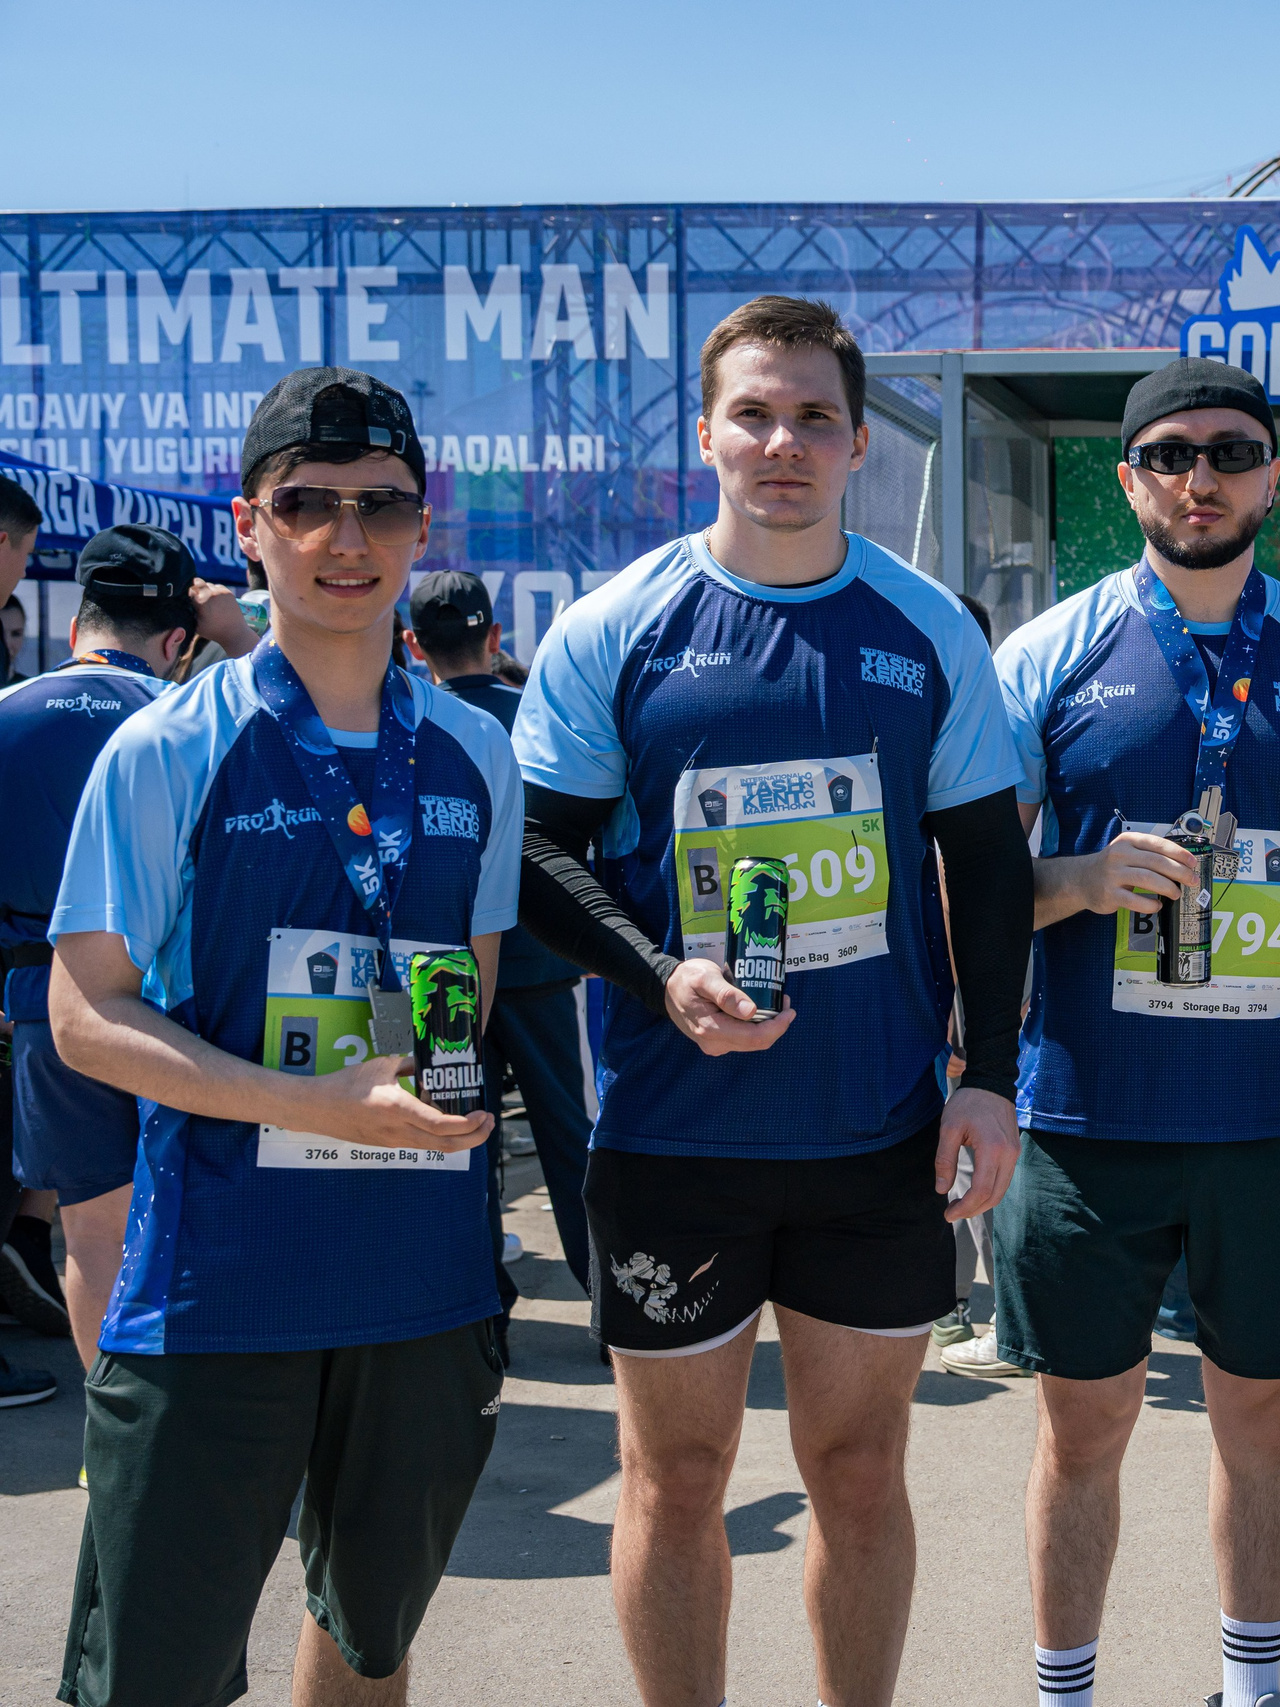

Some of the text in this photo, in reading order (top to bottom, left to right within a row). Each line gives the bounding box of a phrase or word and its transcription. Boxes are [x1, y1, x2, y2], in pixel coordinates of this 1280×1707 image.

[444, 263, 671, 361] MAN
[139, 392, 190, 430] VA
[105, 437, 245, 475] YUGURI
[695, 652, 732, 668] RUN
[860, 650, 917, 681] TASH
[861, 661, 916, 689] KENT
[46, 698, 122, 711] PRO RUN
[1056, 683, 1136, 712] PRO RUN
[1212, 712, 1235, 741] 5K
[740, 776, 804, 794] TASH
[803, 771, 816, 809] 2026
[742, 790, 801, 810] KENT
[743, 801, 808, 816] MARATHON
[225, 806, 323, 834] PRO RUN
[861, 818, 881, 834] 5K
[379, 828, 402, 863] 5K
[1242, 839, 1254, 874] 2026
[353, 855, 380, 896] 5K
[694, 864, 719, 896] B
[784, 845, 876, 902] 609
[1133, 911, 1154, 935] B
[808, 951, 830, 965] Bag
[837, 944, 859, 959] 3609
[741, 980, 768, 989] ENERGY
[1148, 999, 1268, 1015] 3794 Storage Bag 3794
[284, 1031, 312, 1066] B
[422, 1064, 484, 1092] GORILLA
[431, 1090, 461, 1101] ENERGY
[305, 1148, 445, 1163] 3766 Storage Bag 3766
